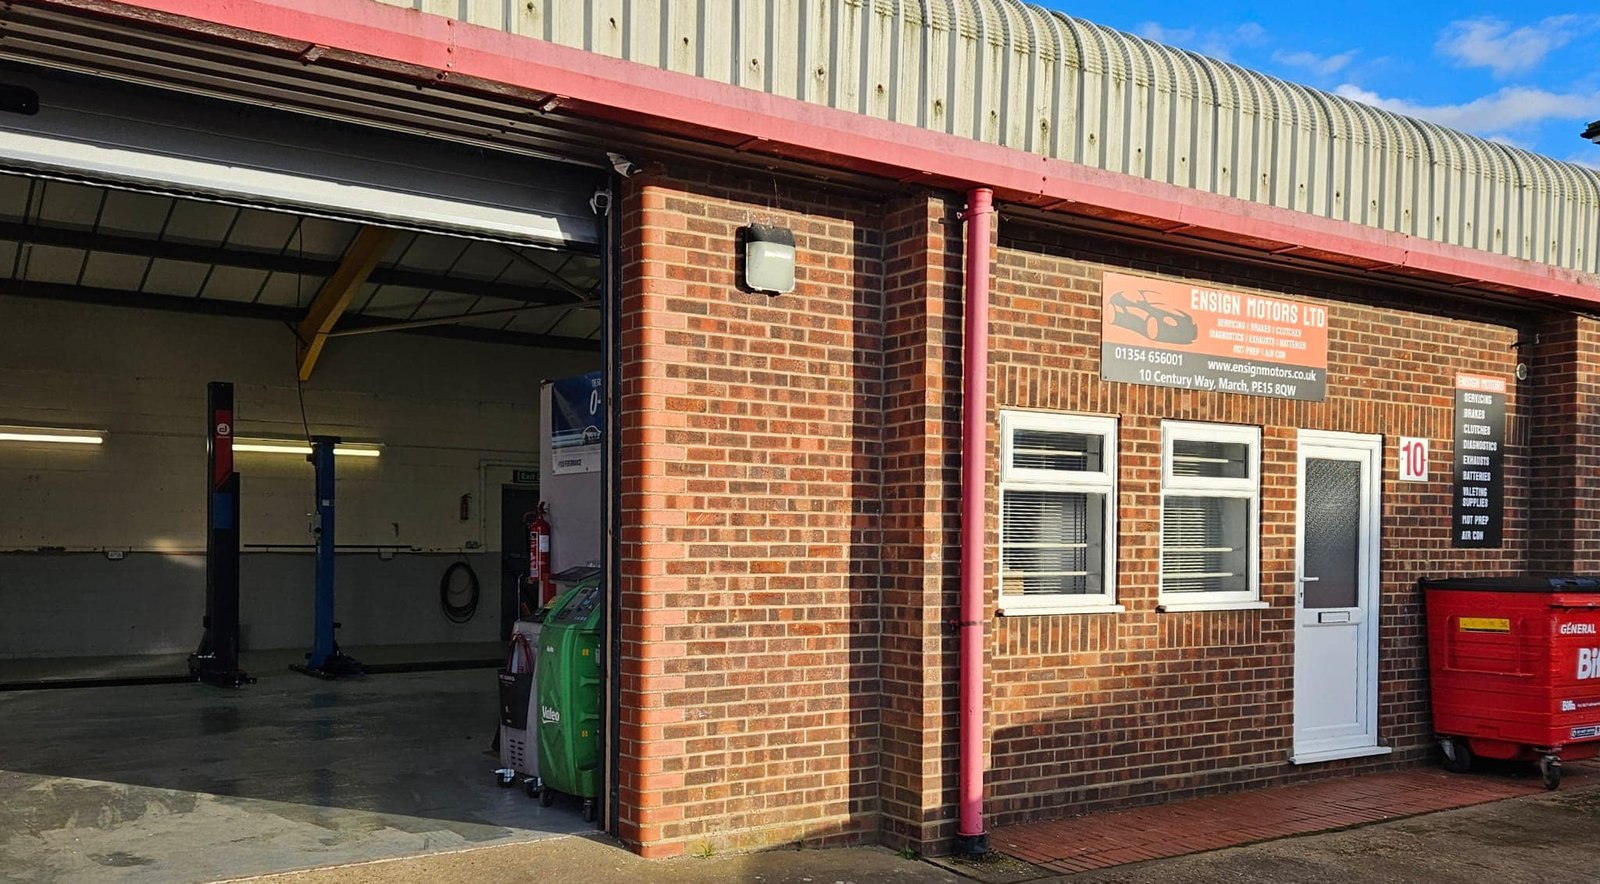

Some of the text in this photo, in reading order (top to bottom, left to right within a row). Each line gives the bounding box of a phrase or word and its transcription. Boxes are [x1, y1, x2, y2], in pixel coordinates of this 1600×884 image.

[1190, 288, 1324, 328] ENSIGN MOTORS LTD
[1115, 346, 1183, 366] 01354 656001
[1208, 359, 1316, 382] www.ensignmotors.co.uk
[1139, 368, 1296, 396] 10 Century Way, March, PE15 8QW
[1464, 392, 1492, 405] SERVICING
[1464, 408, 1485, 419] BRAKES
[1463, 424, 1491, 435] CLUTCHES
[1463, 440, 1497, 451] DIAGNOSTICS
[1402, 441, 1426, 477] 10
[1463, 455, 1490, 466] EXHAUSTS
[1462, 471, 1491, 482] BATTERIES
[1462, 486, 1488, 497] VALETING
[1462, 498, 1488, 508] SUPPLIES
[1462, 515, 1489, 526] MOT PREP
[1461, 530, 1484, 540] AIR CON
[542, 705, 560, 722] Valeo
